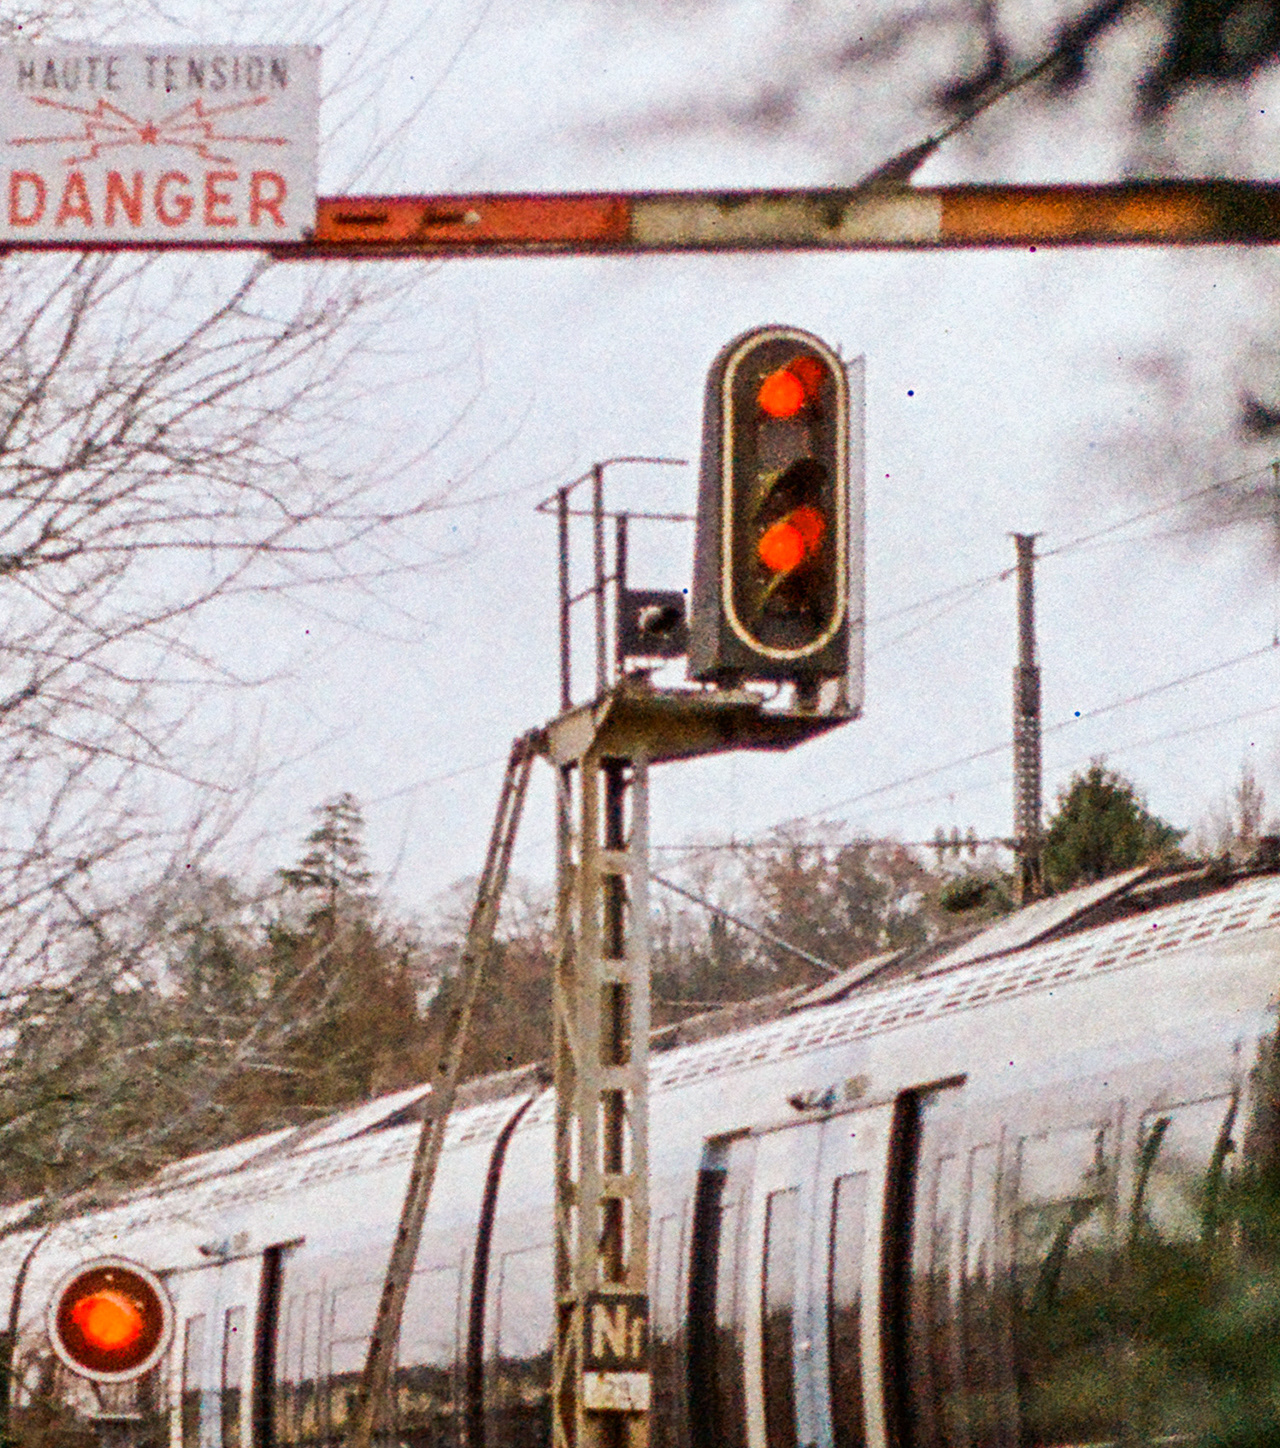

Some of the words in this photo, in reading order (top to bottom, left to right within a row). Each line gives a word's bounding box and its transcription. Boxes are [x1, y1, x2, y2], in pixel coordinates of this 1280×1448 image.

[18, 55, 121, 92] HAUTE
[145, 55, 289, 91] TENSION
[8, 170, 288, 228] DANGER
